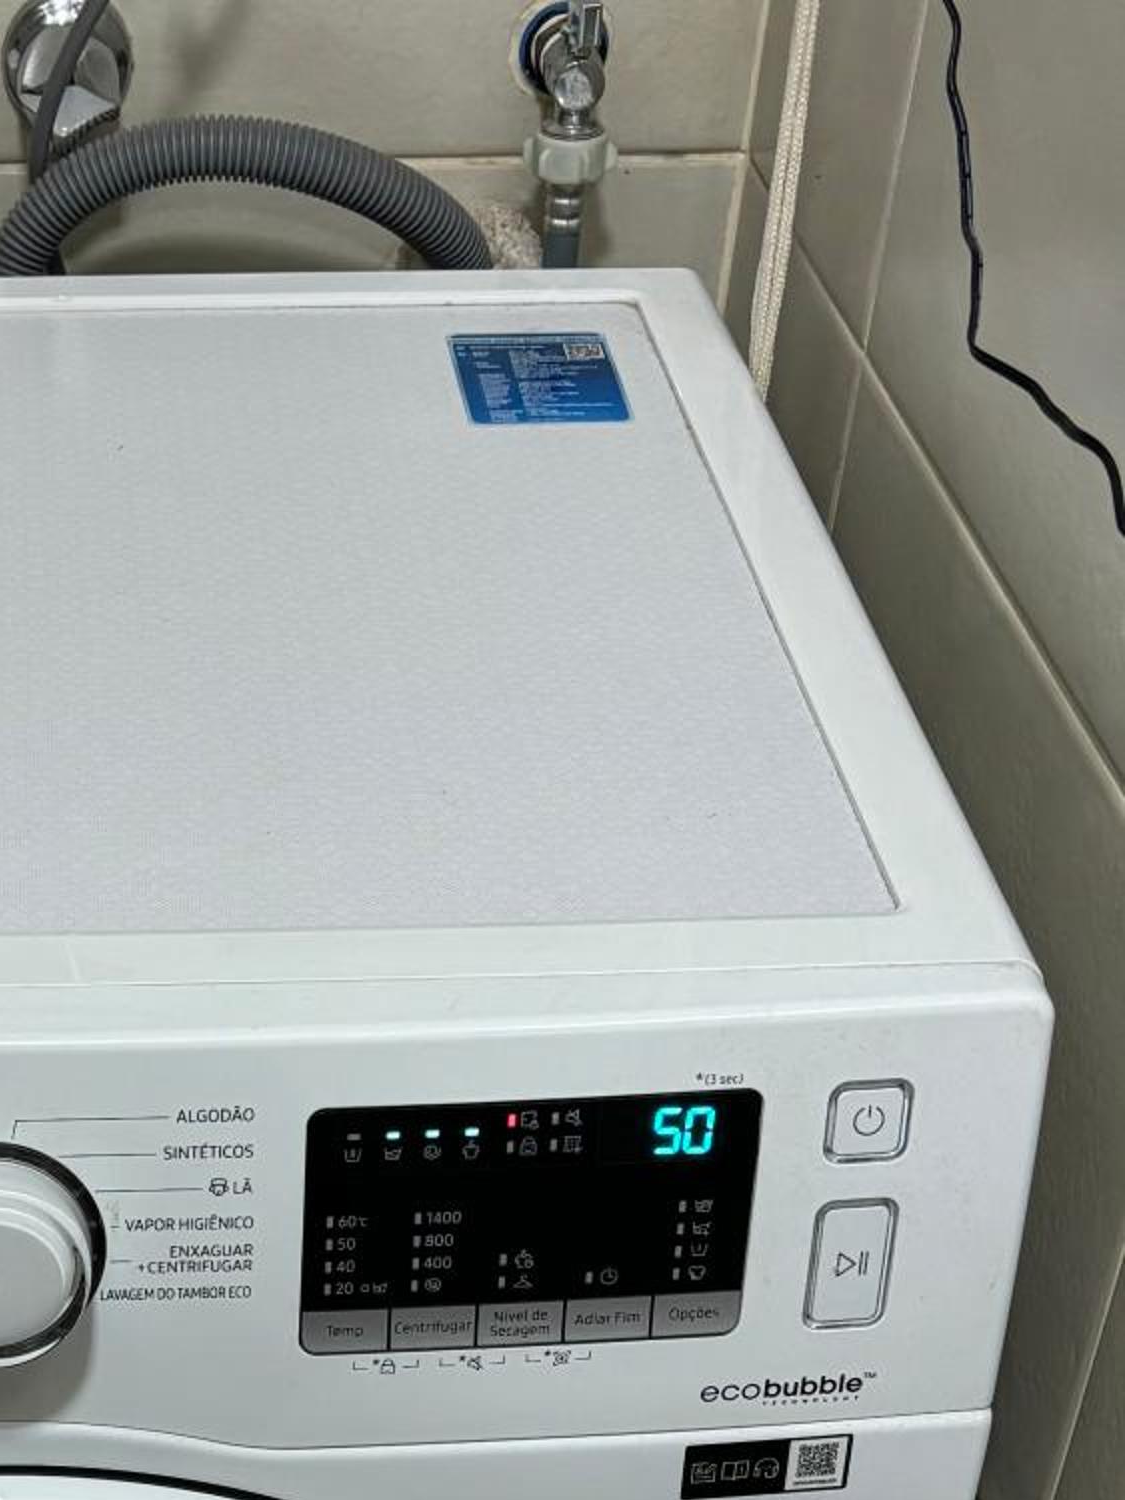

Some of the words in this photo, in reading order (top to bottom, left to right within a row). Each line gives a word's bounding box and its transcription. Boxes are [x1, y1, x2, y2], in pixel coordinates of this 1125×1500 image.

[176, 1105, 255, 1123] ALGODÃO
[163, 1143, 254, 1161] SINTÉTICOS
[233, 1177, 253, 1195] LÃ
[125, 1217, 175, 1231] VAPOR
[178, 1214, 254, 1231] HIGIÊNICO
[426, 1210, 462, 1225] 1400
[337, 1237, 356, 1250] 50
[424, 1233, 455, 1247] 800
[170, 1243, 254, 1258] ENXAGUAR
[336, 1259, 356, 1273] 40
[424, 1256, 452, 1269] 400
[100, 1288, 155, 1301] LAVAGEM
[157, 1287, 175, 1300] DO
[178, 1287, 226, 1300] TAMBOR
[228, 1285, 252, 1299] ECO
[335, 1281, 354, 1295] 20
[394, 1319, 473, 1336] Centrifugar
